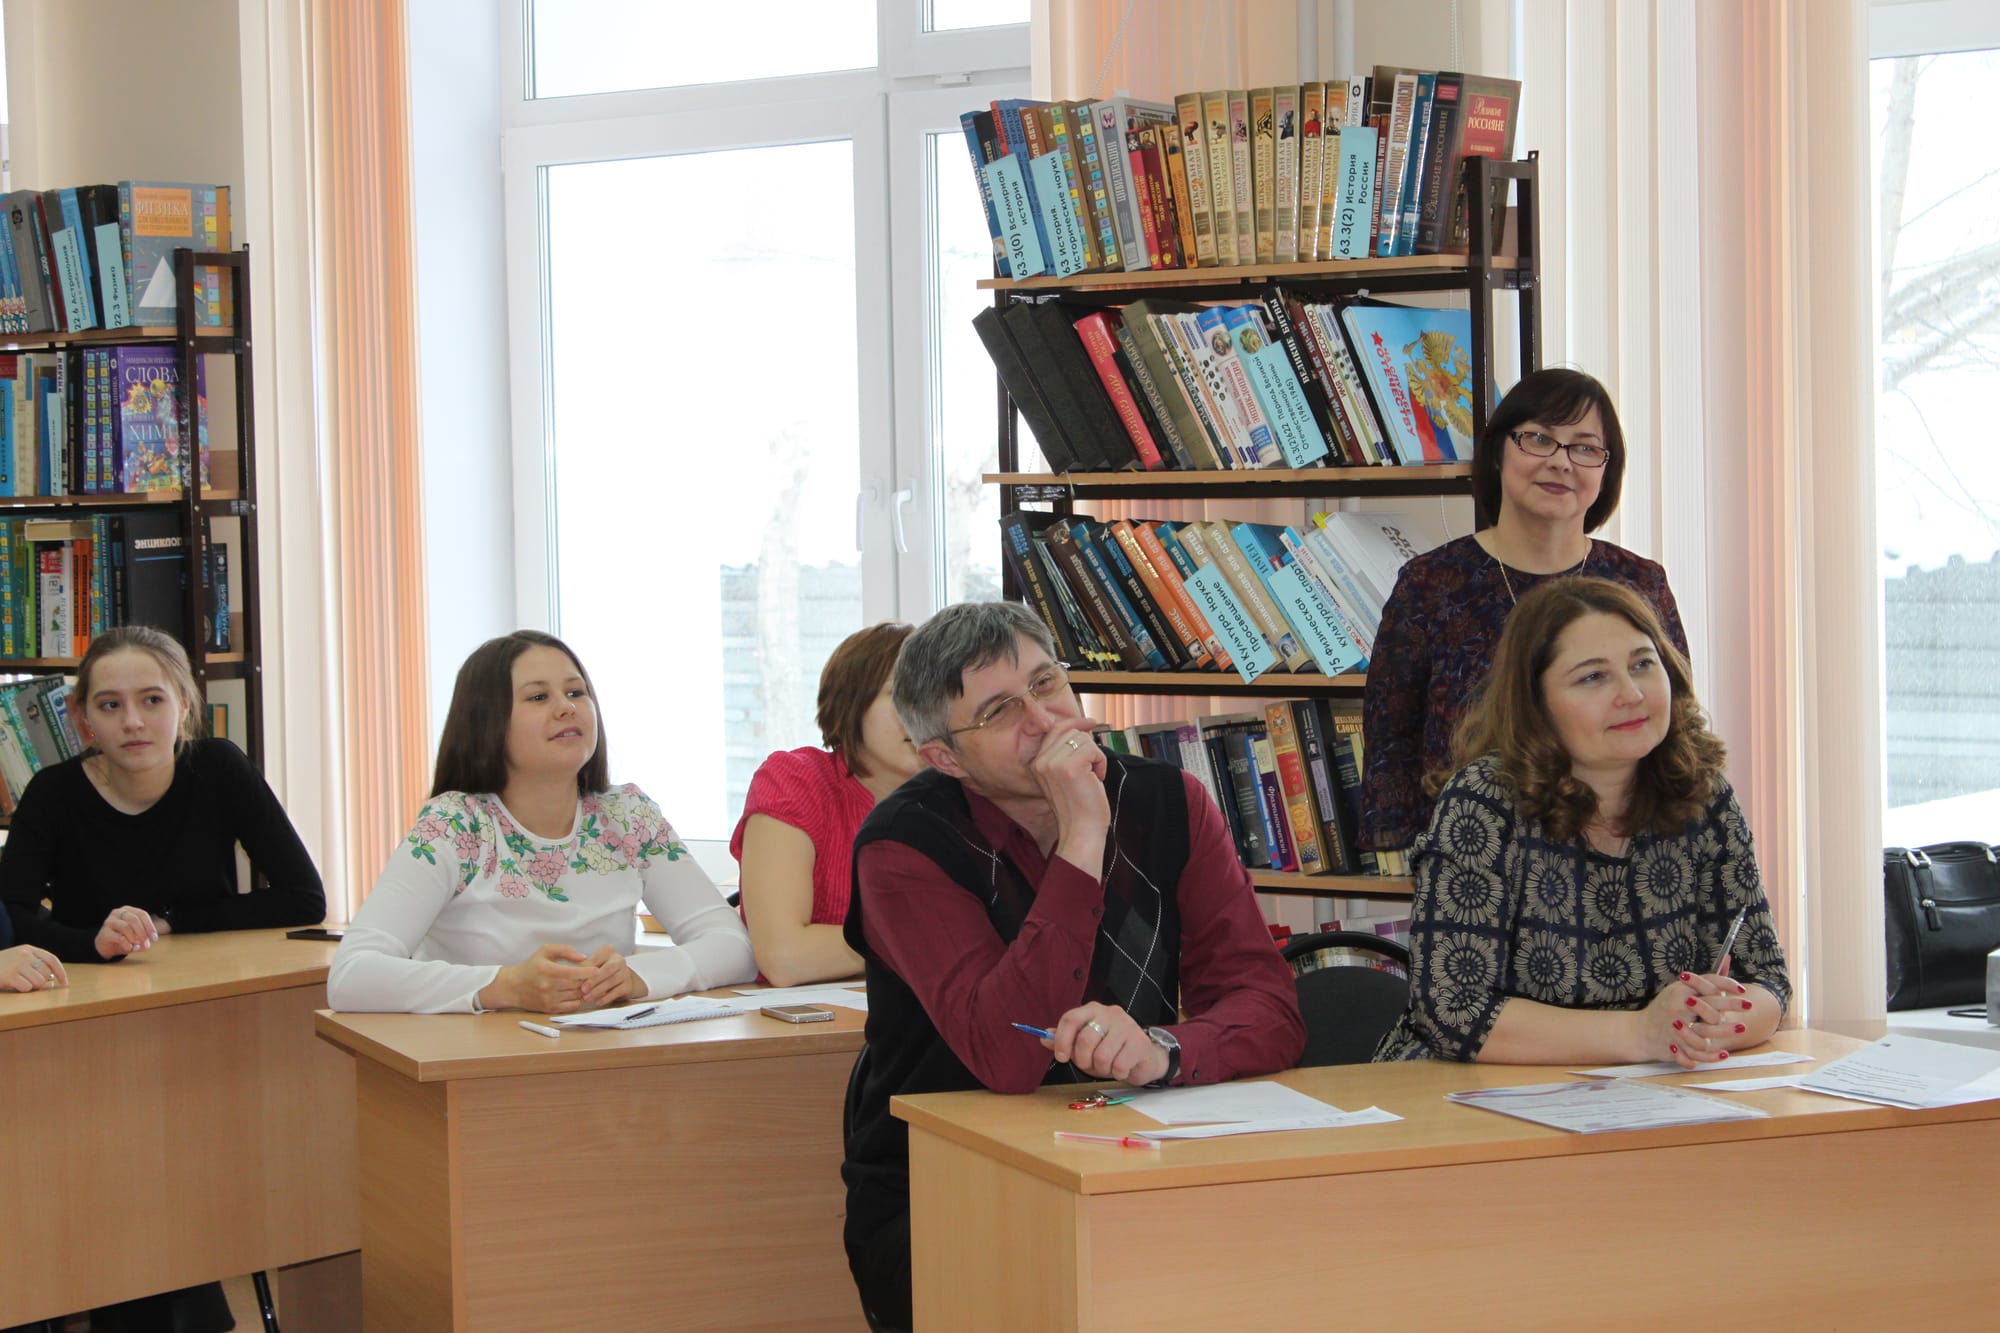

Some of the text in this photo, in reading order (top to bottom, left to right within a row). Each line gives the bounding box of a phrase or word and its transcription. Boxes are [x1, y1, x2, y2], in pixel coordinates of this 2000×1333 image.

[1187, 149, 1200, 208] ШКОЛЬНАЯ
[1212, 147, 1224, 207] ШКОЛЬНАЯ
[1234, 149, 1243, 205] ШКОЛЬНАЯ
[1256, 144, 1265, 205] ШКОЛЬНАЯ
[1278, 142, 1286, 203] ШКОЛЬНАЯ
[1303, 140, 1312, 201] ШКОЛЬНАЯ
[1359, 161, 1369, 203] России
[997, 170, 1028, 276] 63.3(0) Всемирная
[1011, 181, 1028, 225] история
[1050, 156, 1081, 270] Исторические науки
[1340, 154, 1357, 255] 63.3(2) История
[1060, 259, 1071, 275] 63
[1270, 298, 1310, 385] ВЕЛИКИЕ БИТВЫ
[1307, 310, 1331, 358] БЕССМЕРТНО
[125, 367, 180, 383] СЛОВА
[1253, 356, 1273, 390] Великой
[1325, 358, 1340, 378] ТВОЕ
[1269, 388, 1286, 420] Период
[1269, 363, 1309, 450] Отечественной войны
[1286, 377, 1310, 423] (1941-1945)
[1336, 380, 1347, 399] ИМЯ
[129, 424, 178, 442] ХИМИ
[1281, 423, 1305, 465] 63.3(2)622
[134, 537, 182, 550] ЭНЦИКЛОП
[1185, 531, 1205, 556] ДЕТЕЙ
[1211, 528, 1230, 554] ДЕТЕЙ
[1195, 576, 1218, 612] Наука.
[1290, 563, 1313, 593] спорт
[1168, 608, 1192, 642] БИЗНЕС
[1213, 581, 1261, 652] Просвещение
[1294, 597, 1333, 656] Физическая
[1316, 603, 1348, 648] культура
[1245, 661, 1260, 678] 70
[1329, 657, 1345, 673] 75
[1336, 724, 1363, 734] СЛОВАР
